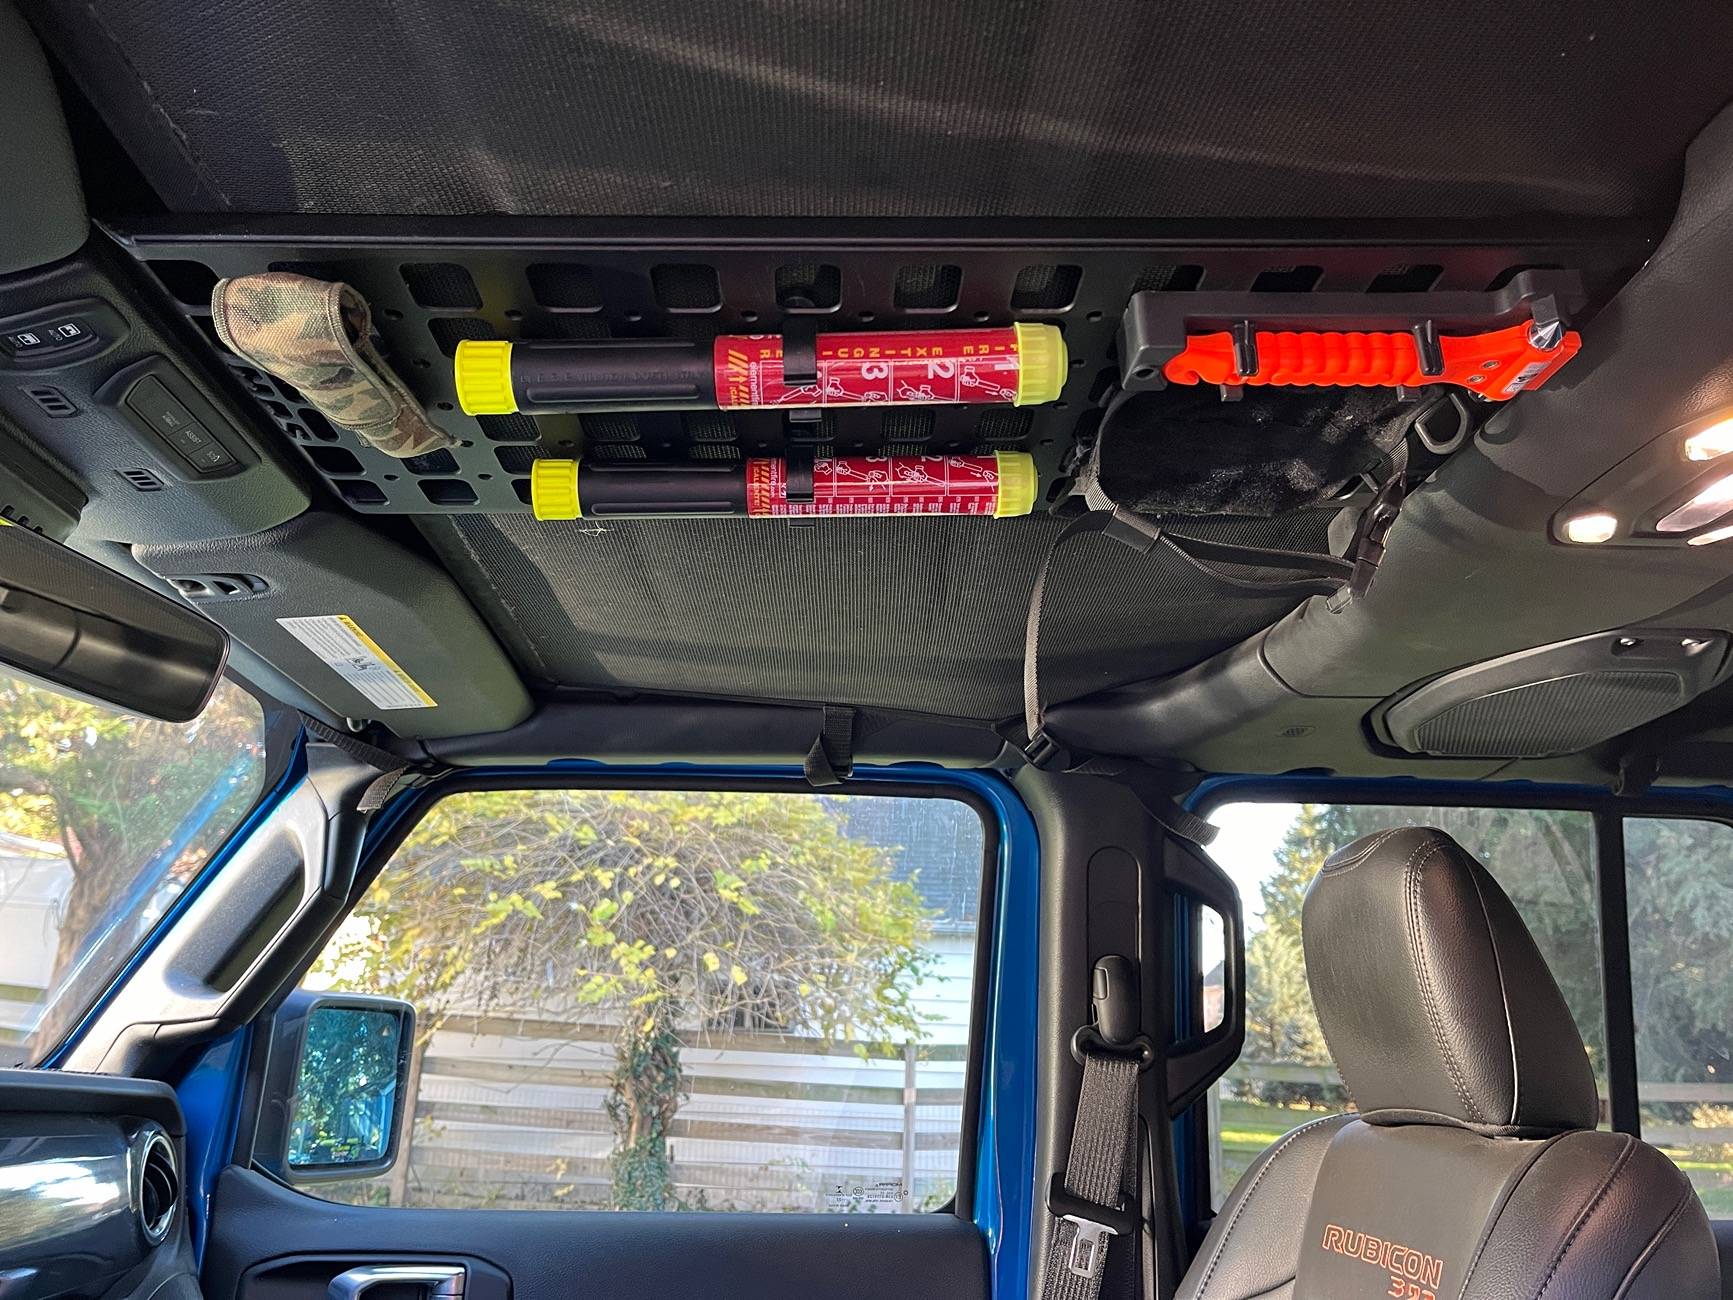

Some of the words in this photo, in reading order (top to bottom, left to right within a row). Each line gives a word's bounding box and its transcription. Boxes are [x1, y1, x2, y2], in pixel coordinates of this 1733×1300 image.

[760, 345, 944, 359] EXTINGUIER
[862, 361, 889, 380] 3
[928, 360, 955, 379] 2
[1322, 1224, 1444, 1290] RUBICON
